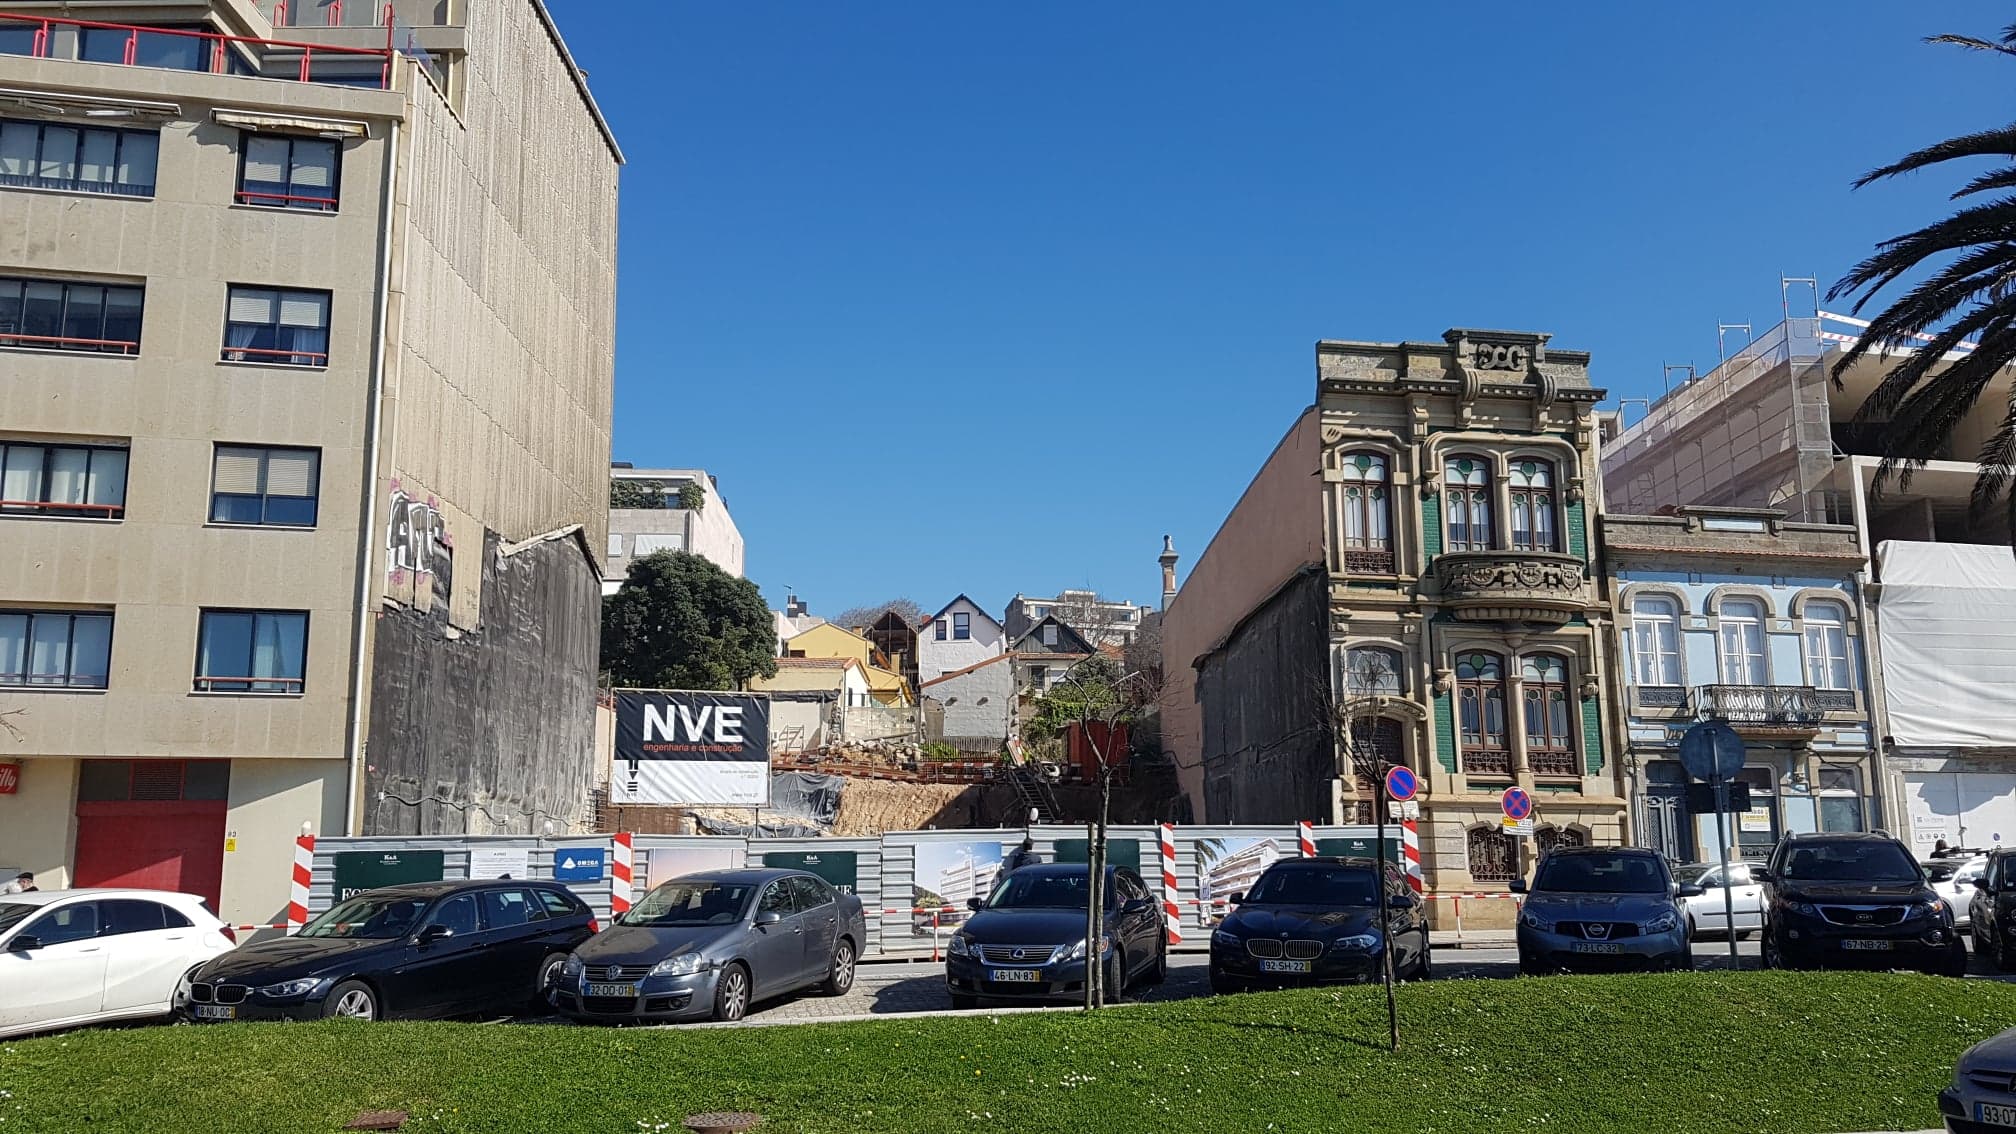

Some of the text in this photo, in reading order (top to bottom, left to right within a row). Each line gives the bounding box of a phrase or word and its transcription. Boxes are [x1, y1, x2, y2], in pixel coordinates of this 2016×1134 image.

[643, 703, 744, 742] NVE
[643, 743, 743, 753] engenharia e construção
